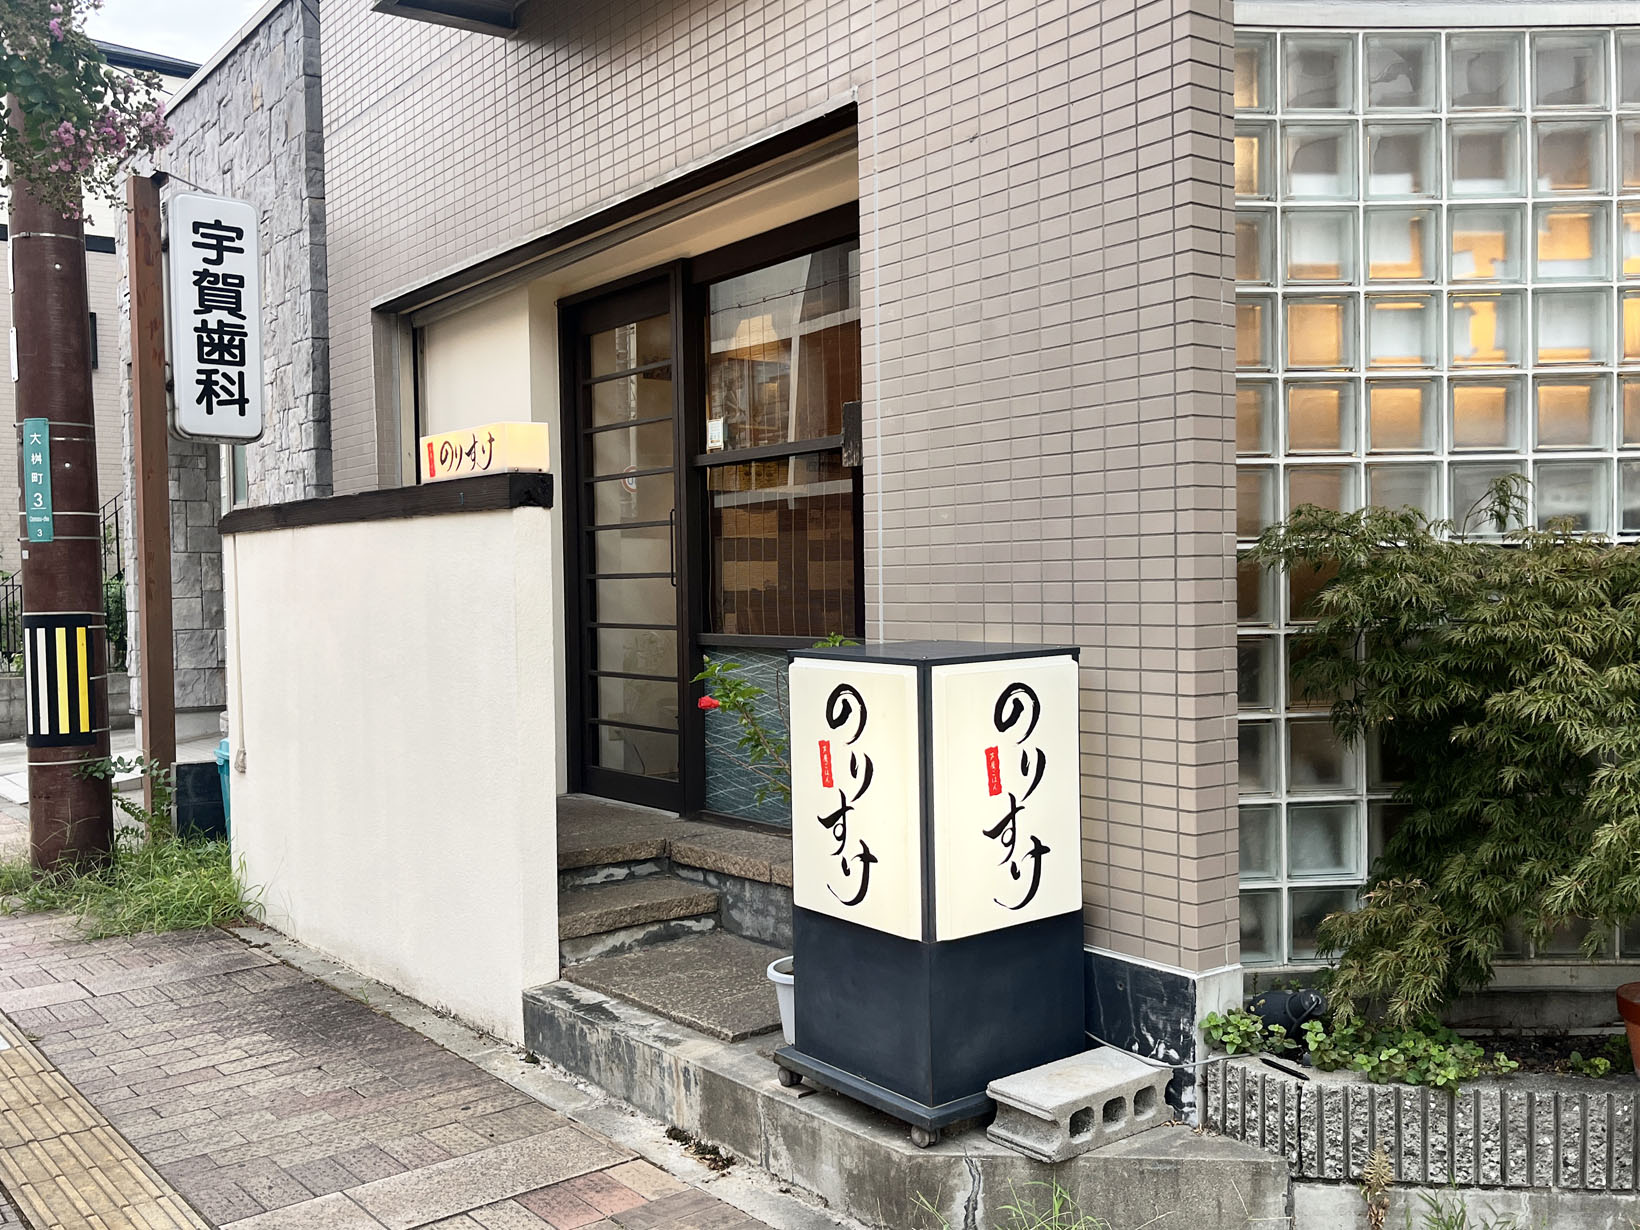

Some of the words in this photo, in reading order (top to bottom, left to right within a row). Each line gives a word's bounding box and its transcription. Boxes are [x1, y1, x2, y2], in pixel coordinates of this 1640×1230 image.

[191, 219, 250, 417] 宇賀歯科
[36, 528, 43, 537] 3
[440, 431, 495, 472] のりすけ
[817, 682, 878, 907] のりすけ
[982, 682, 1051, 910] のりすけ
